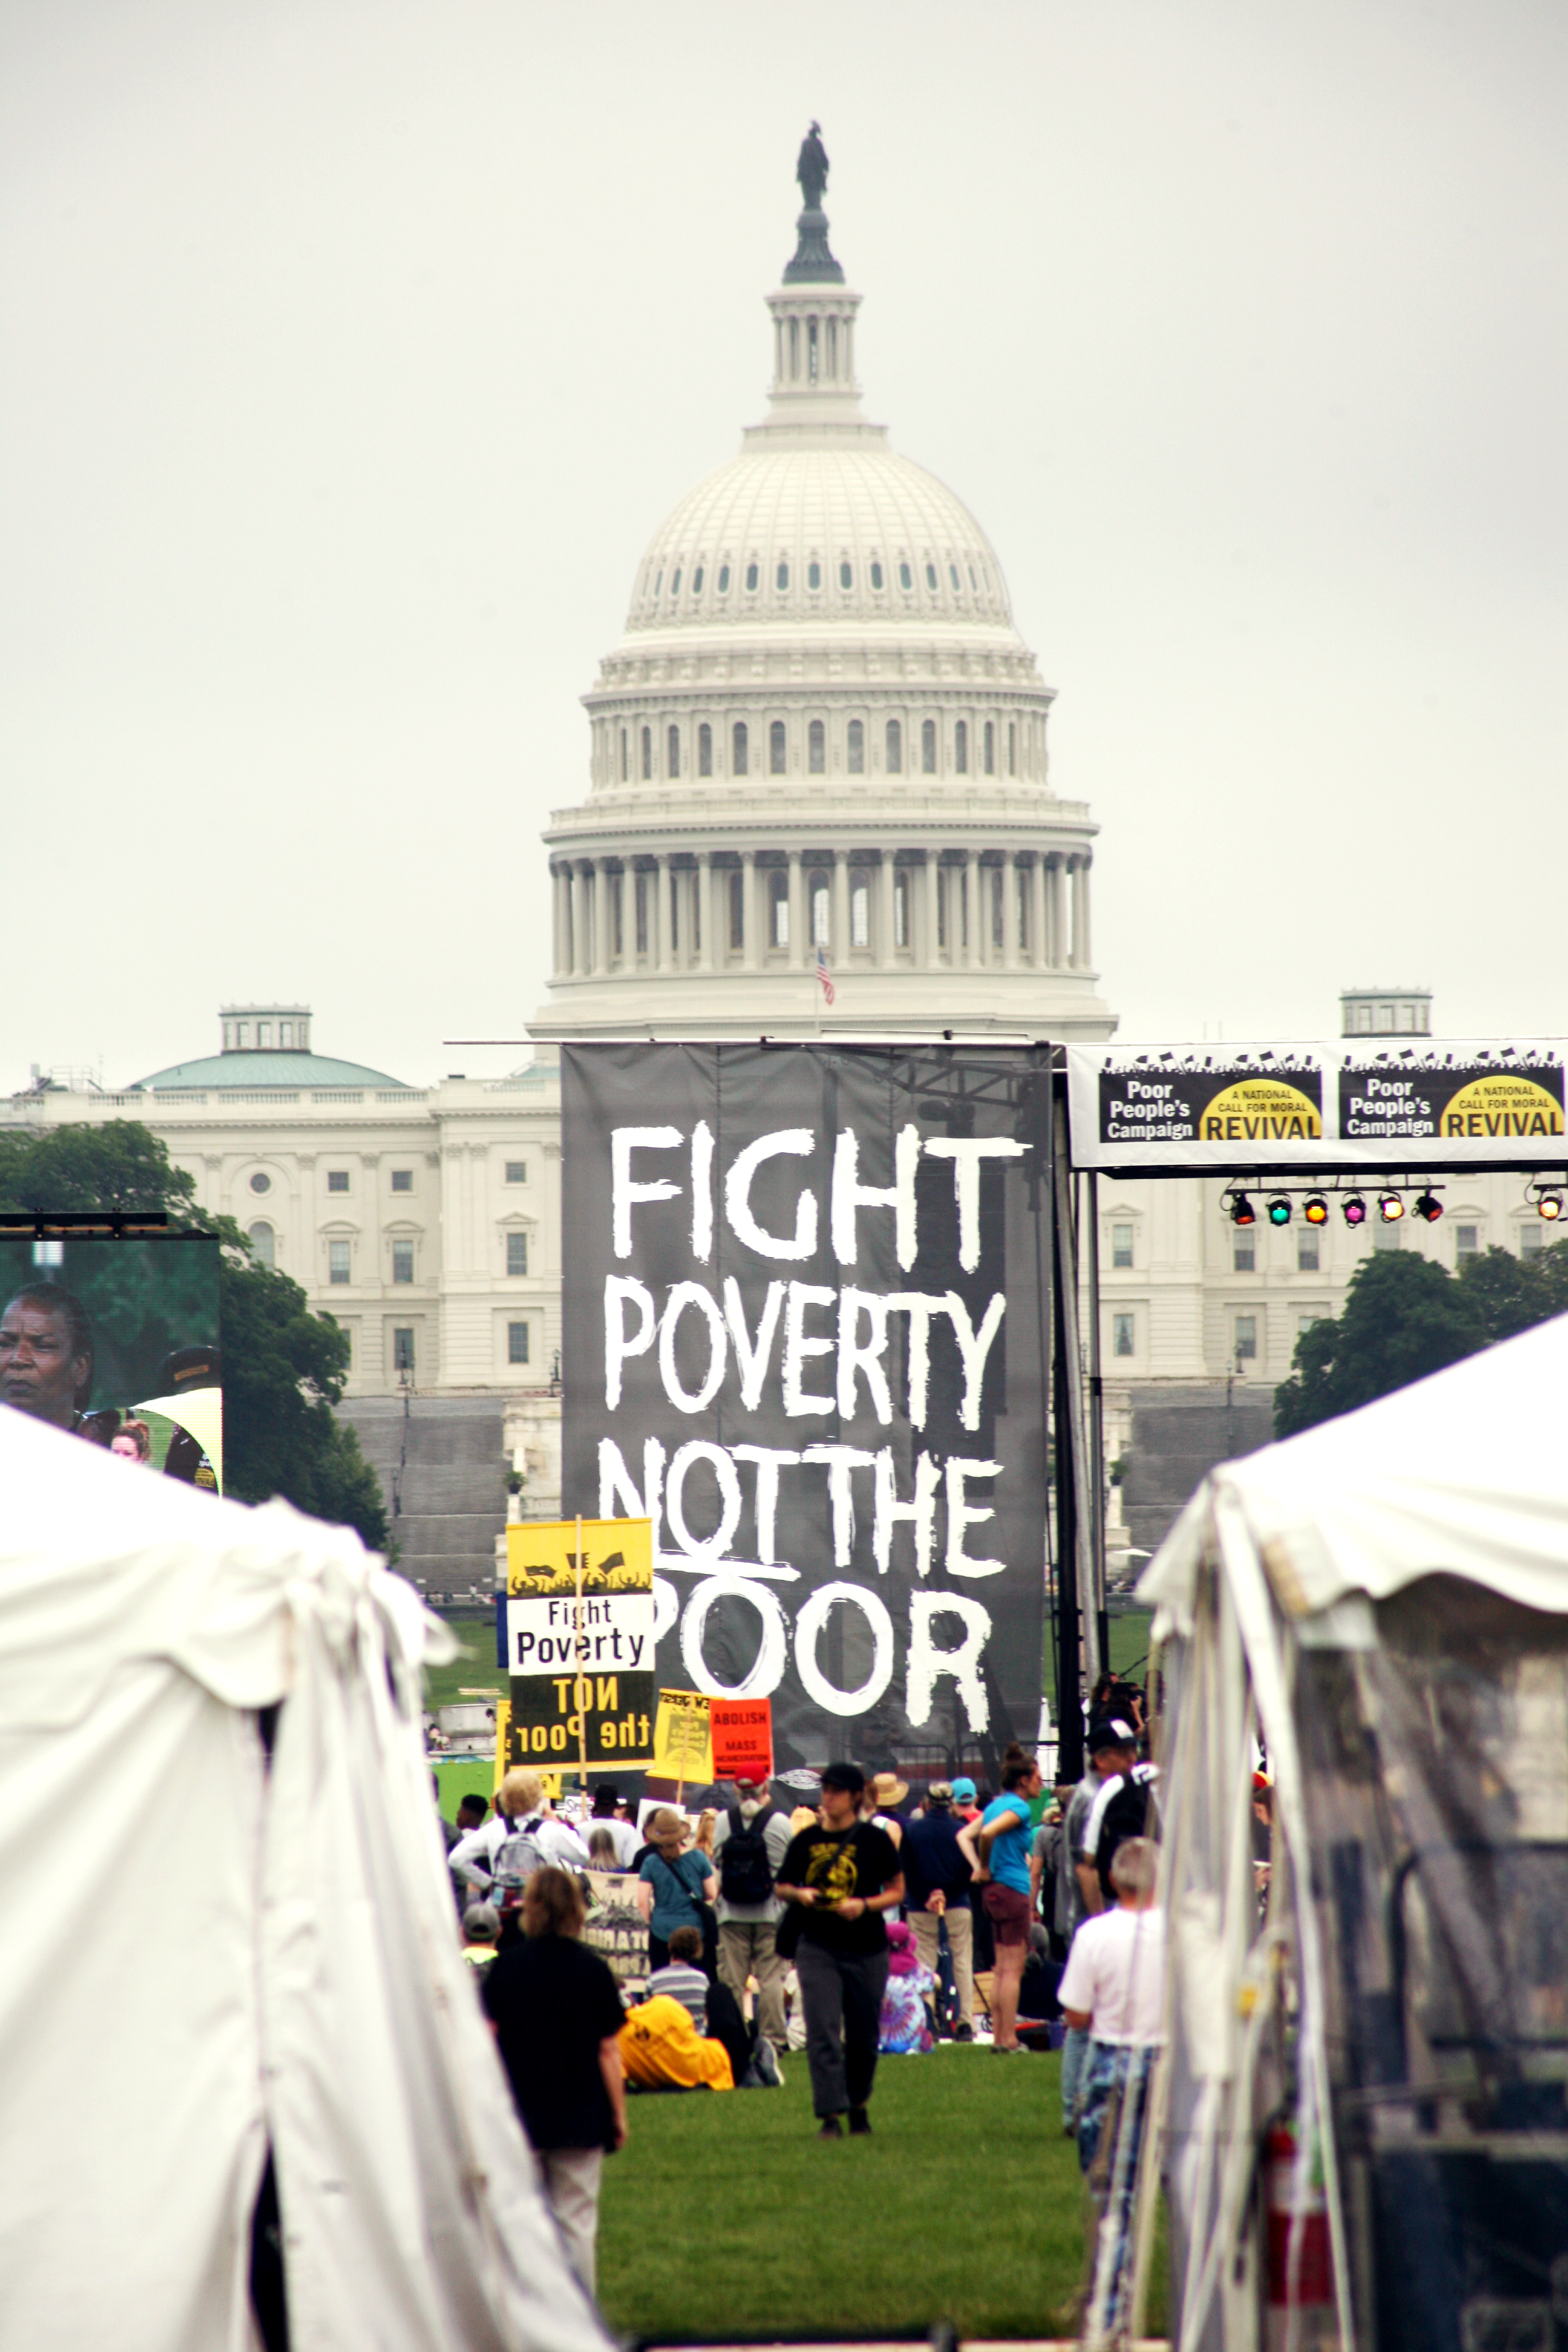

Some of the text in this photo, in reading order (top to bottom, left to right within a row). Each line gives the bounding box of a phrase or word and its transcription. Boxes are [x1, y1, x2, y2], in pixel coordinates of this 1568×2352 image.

[1127, 1080, 1173, 1099] Poor
[1232, 1090, 1293, 1100] A NATIONAL
[1367, 1079, 1414, 1097] Poor
[1473, 1086, 1535, 1097] A NATIONAL
[1110, 1100, 1190, 1121] People's
[1218, 1102, 1307, 1112] CALL FOR MORAL
[1350, 1097, 1431, 1118] People's
[1460, 1099, 1549, 1109] CALL FOR MORAL
[1108, 1121, 1193, 1140] Campaign
[1206, 1116, 1321, 1140] REVIVAL
[1348, 1118, 1434, 1137] Campaign
[1448, 1112, 1564, 1137] REVIVAL
[611, 1120, 1033, 1273] FIGHT
[604, 1275, 1006, 1432] POVERTY
[598, 1437, 1007, 1578] NOT THE
[549, 1599, 612, 1630] Fight
[517, 1628, 644, 1667] Poverty
[714, 1712, 767, 1725] ABOLISH
[726, 1740, 757, 1751] MASS
